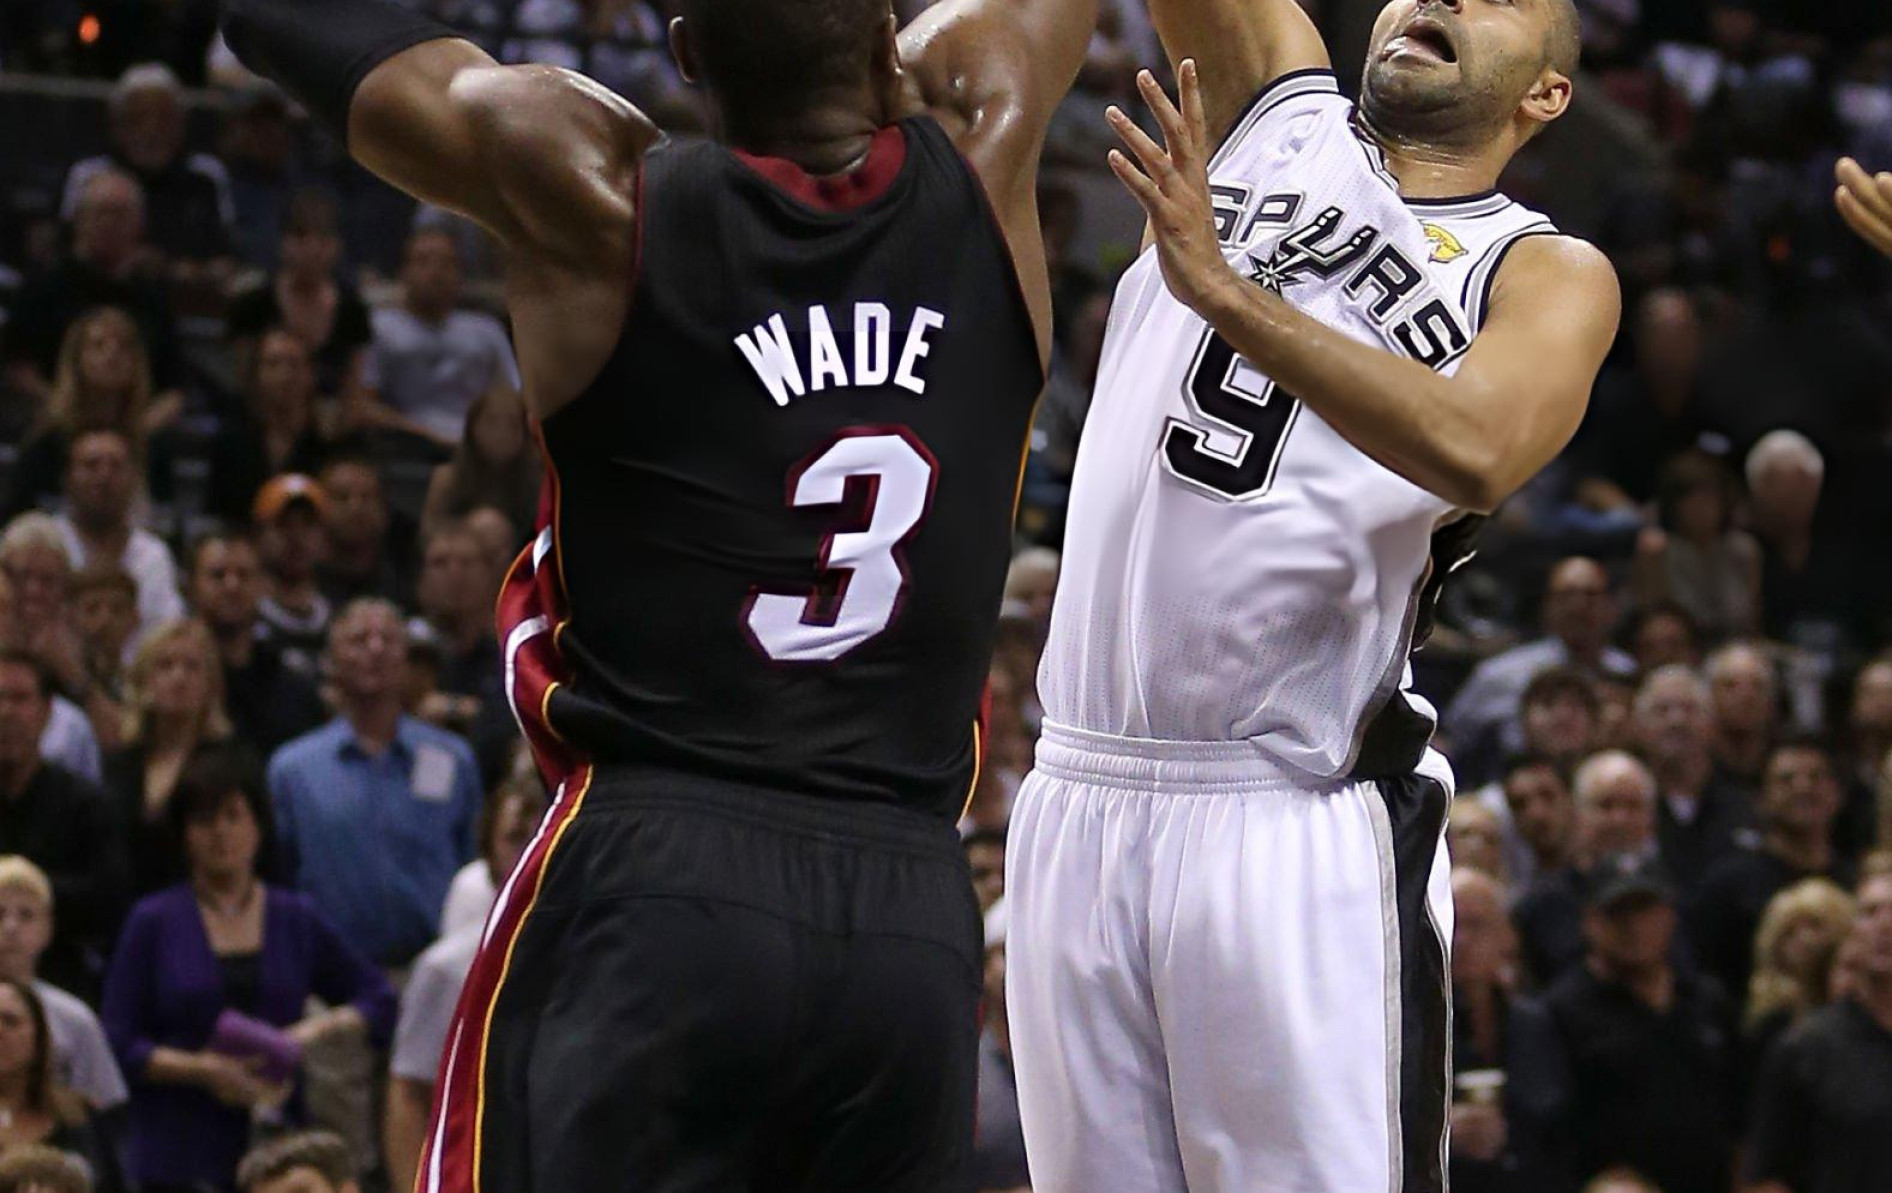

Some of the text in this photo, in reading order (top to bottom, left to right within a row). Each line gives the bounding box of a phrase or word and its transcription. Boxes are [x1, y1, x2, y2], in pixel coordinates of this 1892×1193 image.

[733, 302, 945, 407] WADE
[1159, 324, 1302, 503] 9
[742, 426, 940, 665] 3
